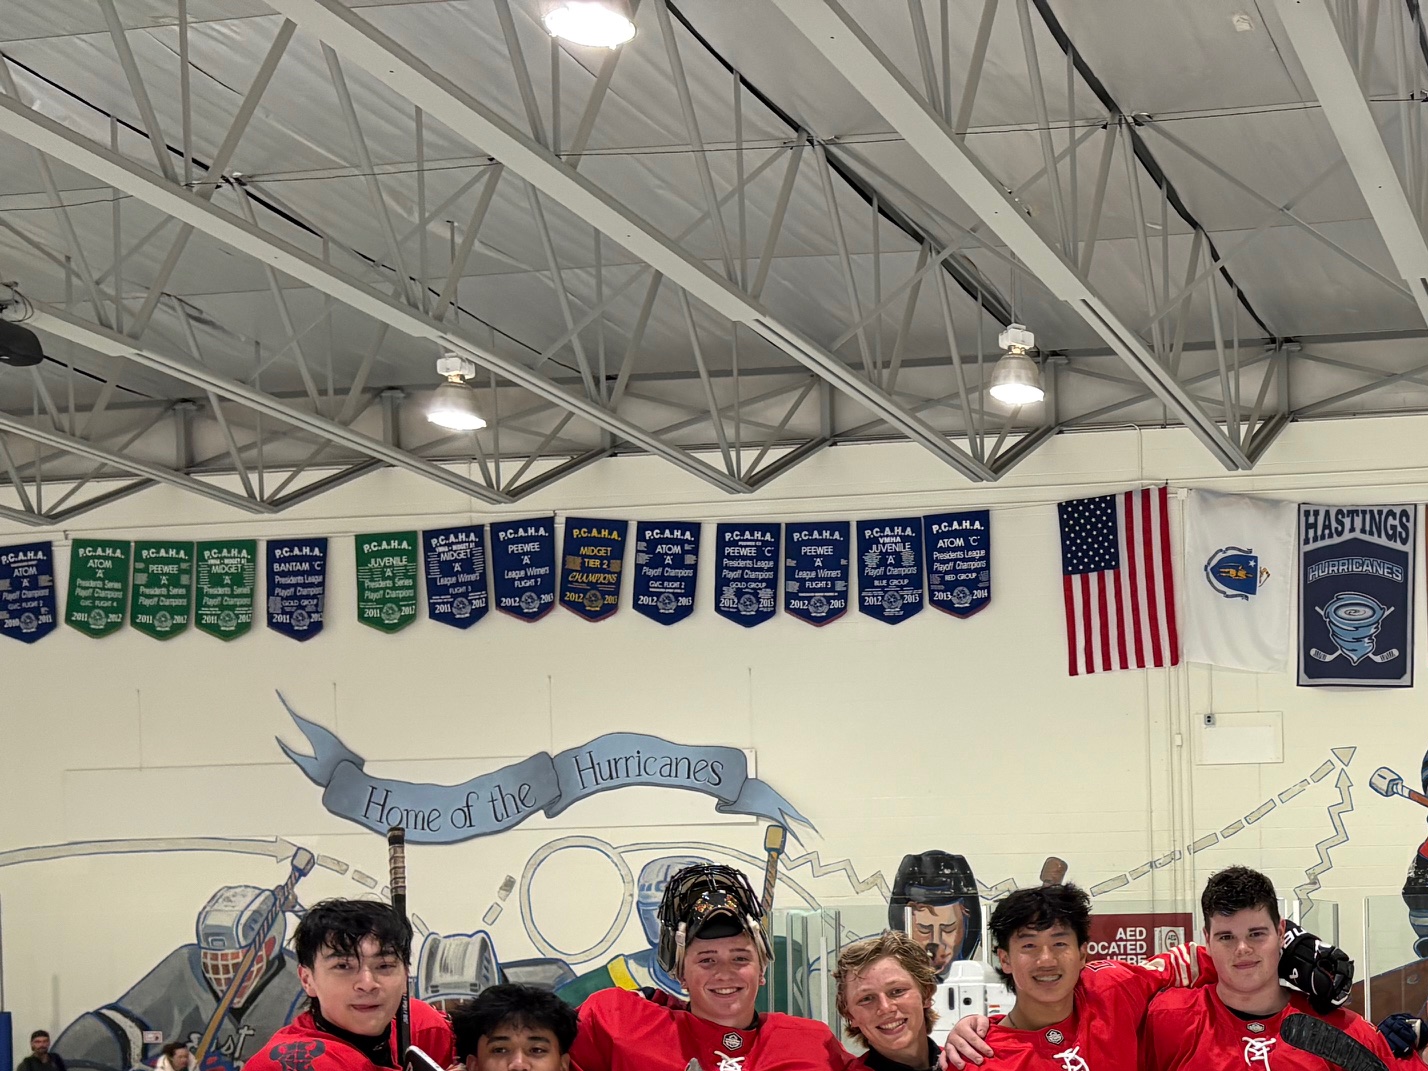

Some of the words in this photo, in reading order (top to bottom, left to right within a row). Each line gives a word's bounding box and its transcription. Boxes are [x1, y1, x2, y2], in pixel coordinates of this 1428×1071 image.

[932, 520, 984, 533] P.C.A.H.A.
[1303, 508, 1410, 546] HASTINGS
[499, 527, 549, 541] P.C.A.H.A.
[573, 528, 621, 541] P.C.A.H.A.
[645, 529, 694, 541] P.C.A.H.A.
[724, 531, 774, 542] P.C.A.H.A.
[793, 530, 844, 542] P.C.A.H.A.
[864, 527, 915, 539] P.C.A.H.A.
[430, 533, 478, 547] P.C.A.H.A.
[937, 537, 965, 548] ATOM
[363, 540, 411, 553] P.C.A.H.A.
[508, 543, 540, 553] PEEWEE
[580, 546, 612, 556] MIDGET
[655, 544, 681, 554] ATOM
[724, 547, 757, 556] PEEWEE
[801, 546, 833, 555] PEEWEE
[868, 543, 912, 553] JUVENILE
[78, 548, 125, 559] P.C.A.H.A.
[142, 549, 188, 559] P.C.A.H.A.
[203, 548, 251, 559] P.C.A.H.A.
[274, 547, 323, 558] P.C.A.H.A.
[440, 550, 471, 561] MIDGET
[87, 559, 112, 568] ATOM
[273, 562, 310, 572] BANTAM
[367, 556, 408, 567] JUVENILE
[584, 558, 601, 568] TIER
[13, 567, 37, 577] ATOM
[148, 565, 178, 573] PEEWEE
[211, 565, 242, 573] MIDGET
[1307, 557, 1403, 583] HURRICANES
[362, 784, 442, 832] Home
[450, 791, 480, 828] of
[488, 782, 536, 822] the
[572, 750, 724, 791] Hurricanes
[1116, 927, 1147, 940] AED
[1087, 942, 1147, 954] OCATED
